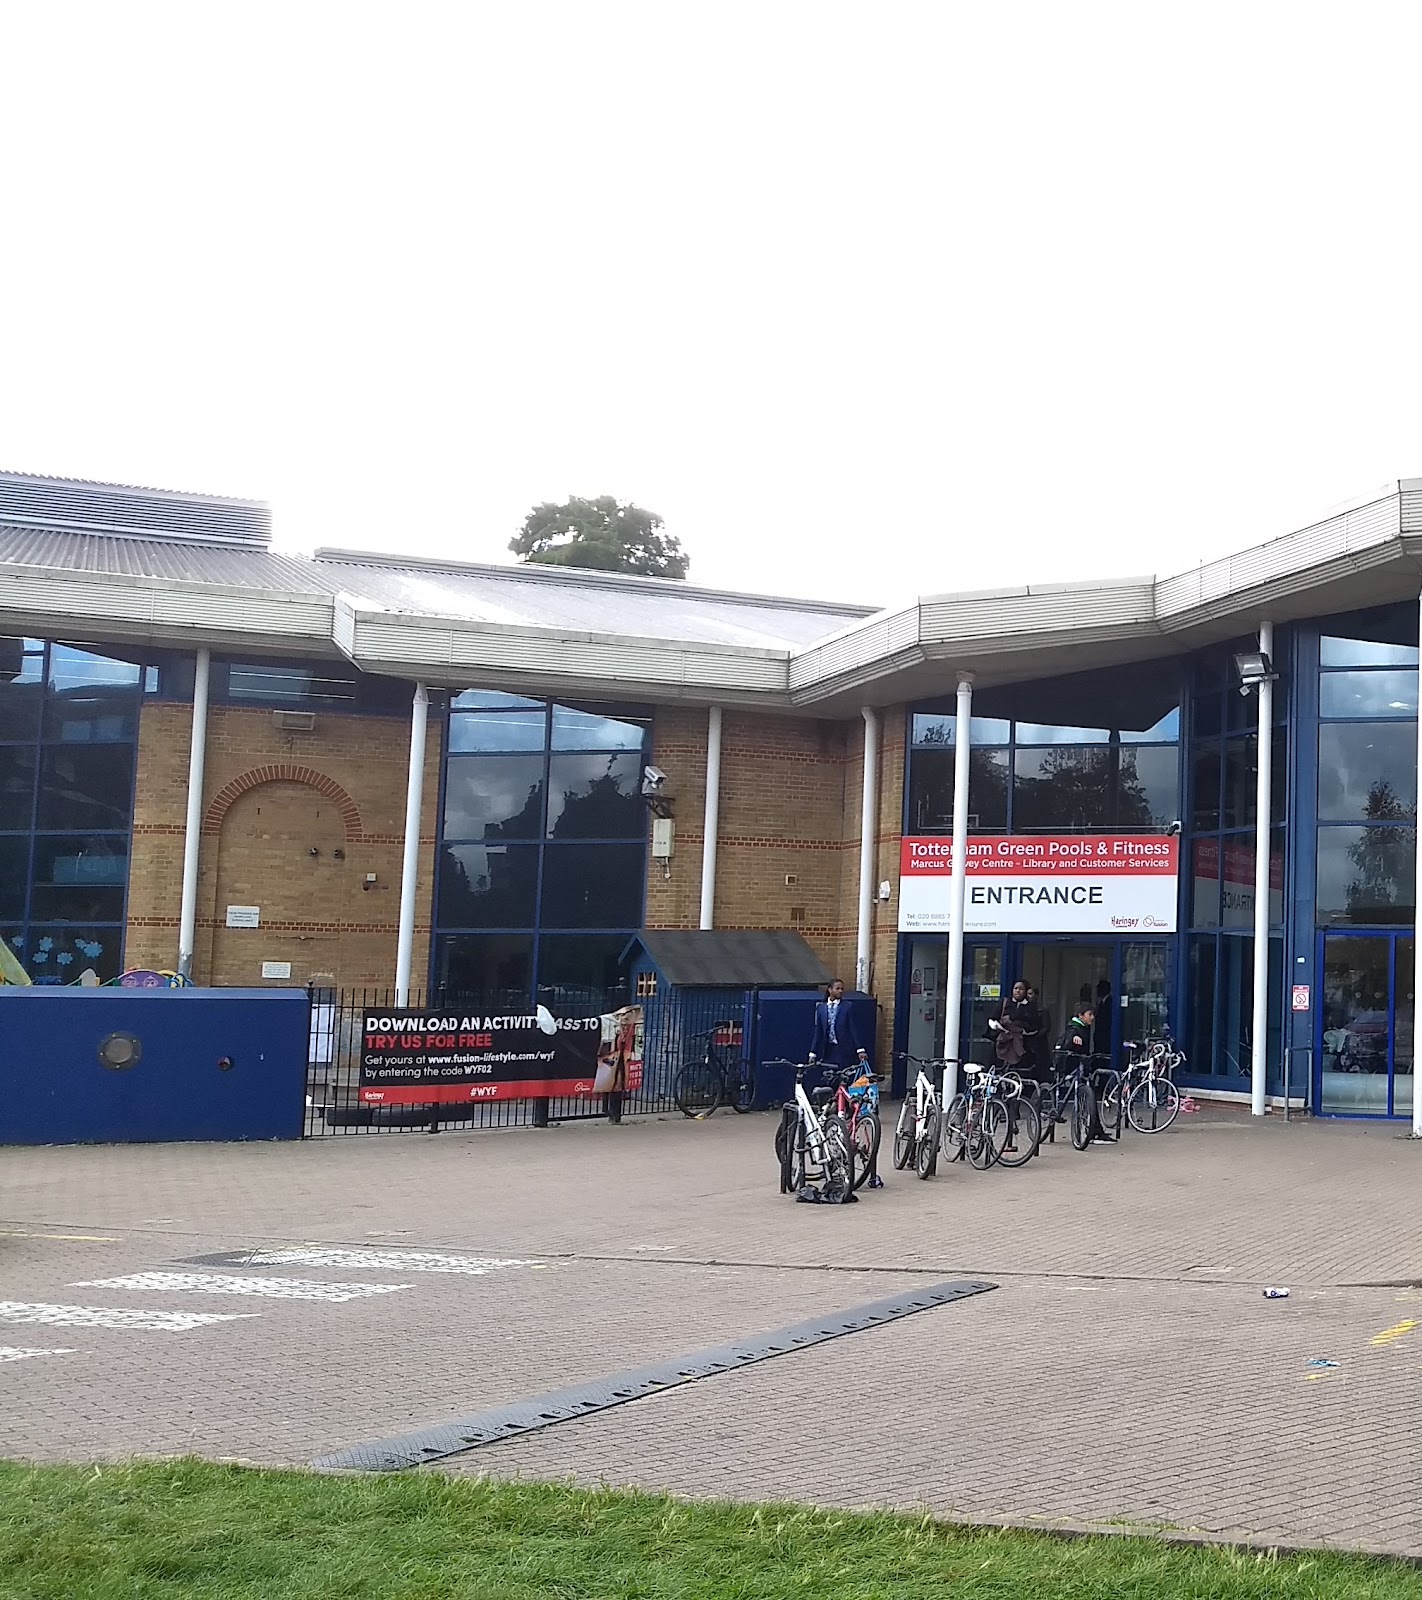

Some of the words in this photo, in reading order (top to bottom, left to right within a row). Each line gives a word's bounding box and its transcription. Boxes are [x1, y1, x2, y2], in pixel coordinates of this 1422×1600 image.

[909, 842, 993, 856] Totteam
[997, 841, 1045, 856] Green
[1049, 840, 1093, 856] Pools
[1097, 841, 1108, 855] &
[1113, 841, 1170, 855] Fitness
[910, 859, 945, 868] Marcus
[946, 859, 980, 869] Gvey
[981, 859, 1014, 868] Centre
[1022, 858, 1057, 869] Library
[1059, 858, 1078, 868] and
[1079, 858, 1126, 868] Customer
[1128, 857, 1170, 868] Services
[971, 886, 1103, 904] ENTRANCE
[1111, 915, 1139, 927] Haringey
[366, 1017, 458, 1032] DOWNLOAD
[459, 1016, 480, 1031] AN
[555, 1017, 581, 1031] ASS
[581, 1017, 599, 1031] TO
[365, 1034, 398, 1049] TRY
[401, 1034, 422, 1048] US
[425, 1034, 455, 1048] FOR
[458, 1033, 492, 1048] FREE
[364, 1054, 383, 1065] Get
[384, 1056, 413, 1067] yours
[415, 1054, 426, 1064] at
[428, 1051, 555, 1064] www.fusion-lifestyle.com/wyf
[364, 1067, 377, 1080] by
[378, 1066, 421, 1079] entering
[423, 1066, 439, 1076] the
[441, 1065, 463, 1076] code
[464, 1064, 492, 1075] WYF02
[470, 1086, 498, 1097] #WYF
